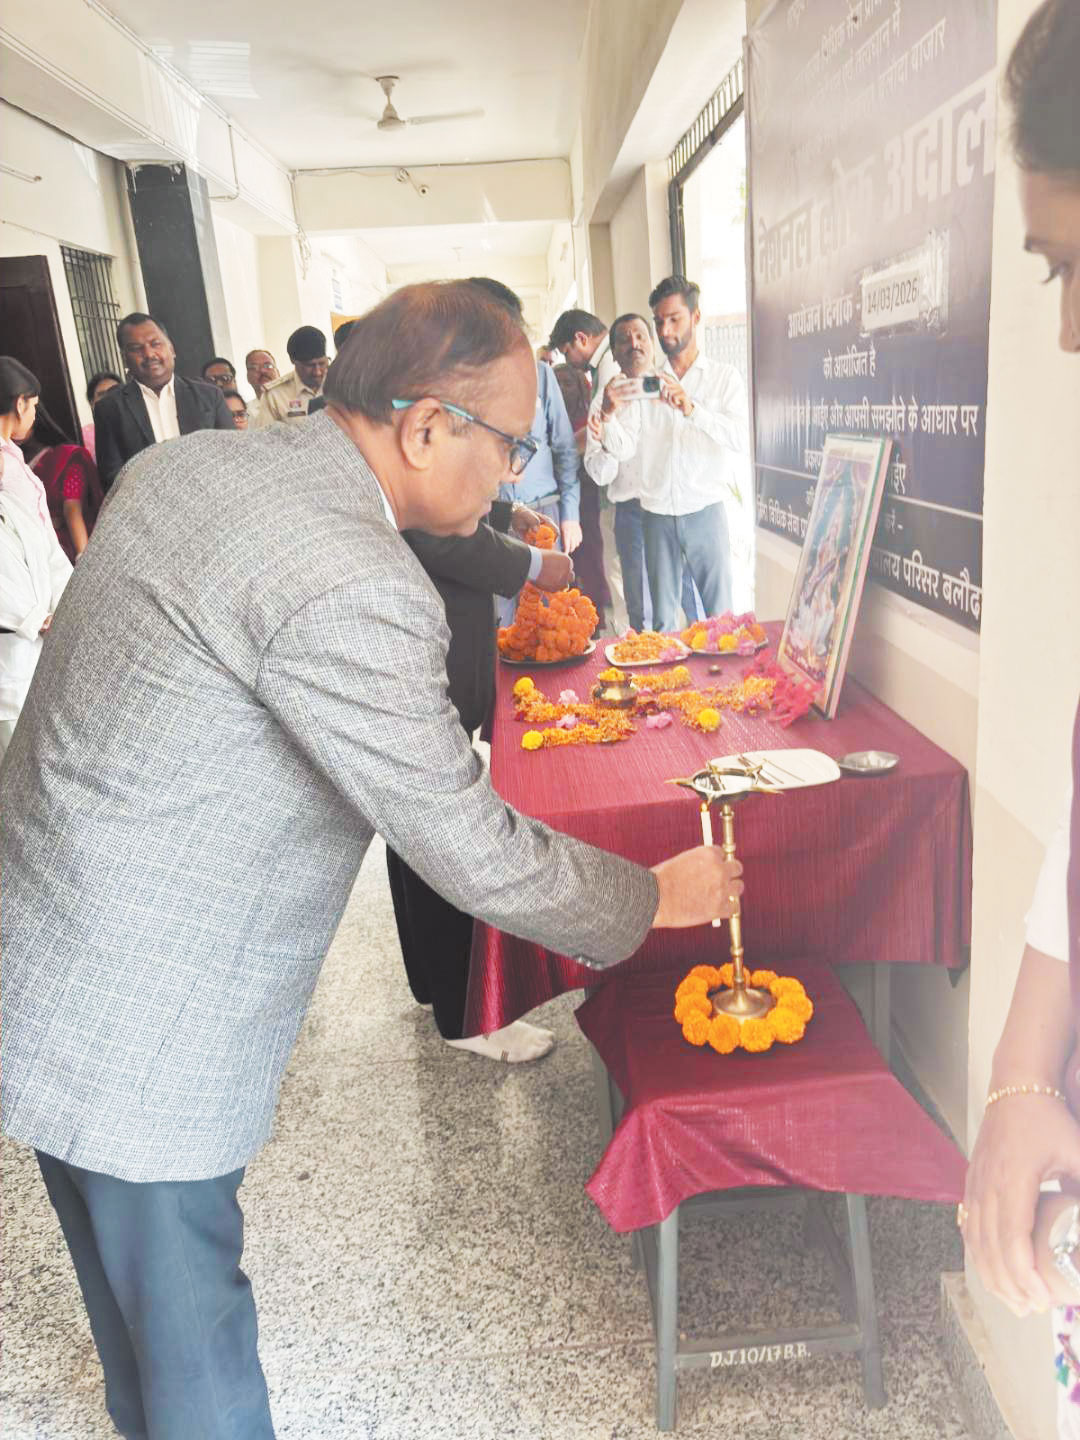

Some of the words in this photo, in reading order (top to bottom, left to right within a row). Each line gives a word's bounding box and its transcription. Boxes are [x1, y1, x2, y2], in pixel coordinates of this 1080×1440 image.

[787, 303, 821, 339] आयोजन
[866, 277, 919, 314] 14/03/2026
[921, 404, 959, 436] आधार
[961, 405, 980, 438] पर
[902, 550, 940, 600] परिसर
